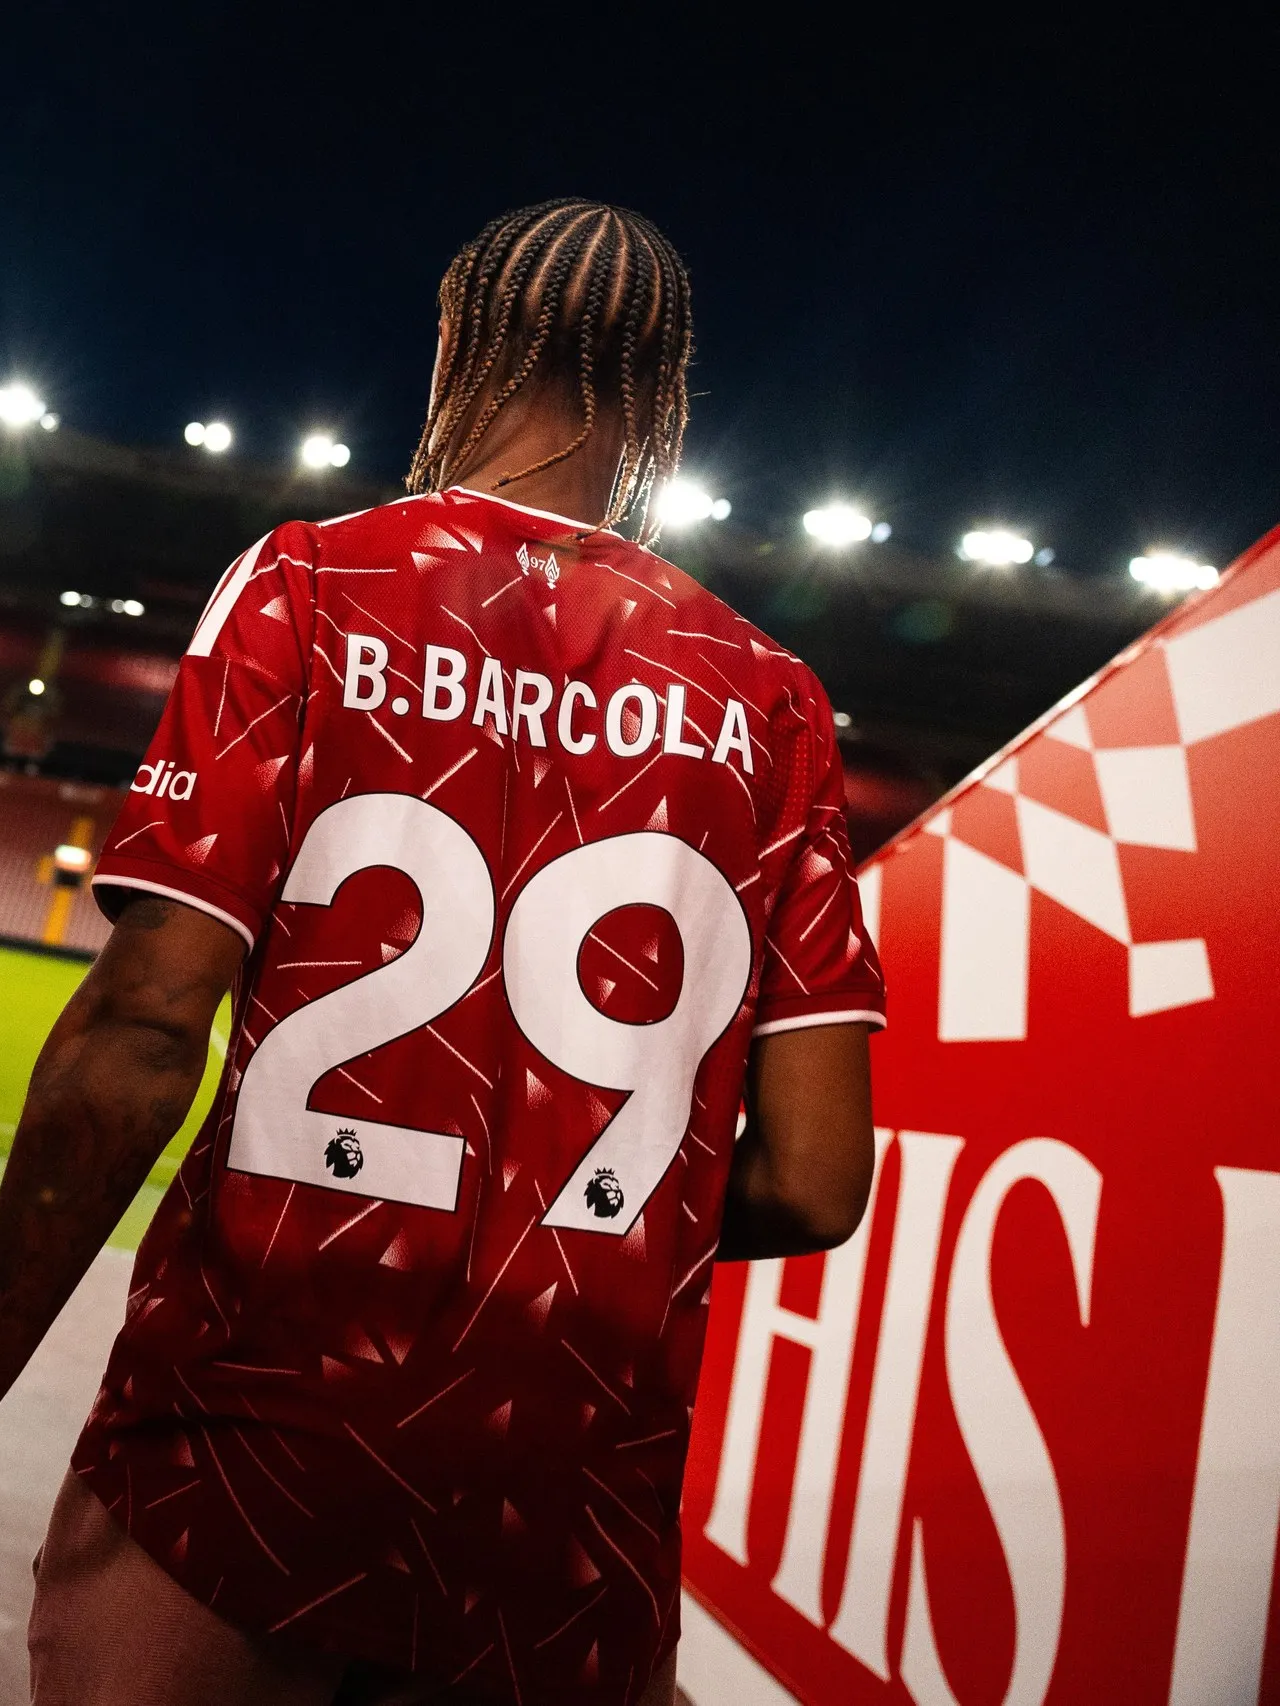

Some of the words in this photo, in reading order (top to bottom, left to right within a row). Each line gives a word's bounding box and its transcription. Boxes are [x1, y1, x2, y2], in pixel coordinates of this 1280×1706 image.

[530, 556, 546, 571] 97
[342, 634, 756, 777] B.BARCOLA
[130, 759, 198, 801] dia
[227, 792, 752, 1236] 29
[703, 1112, 1104, 1706] HIS
